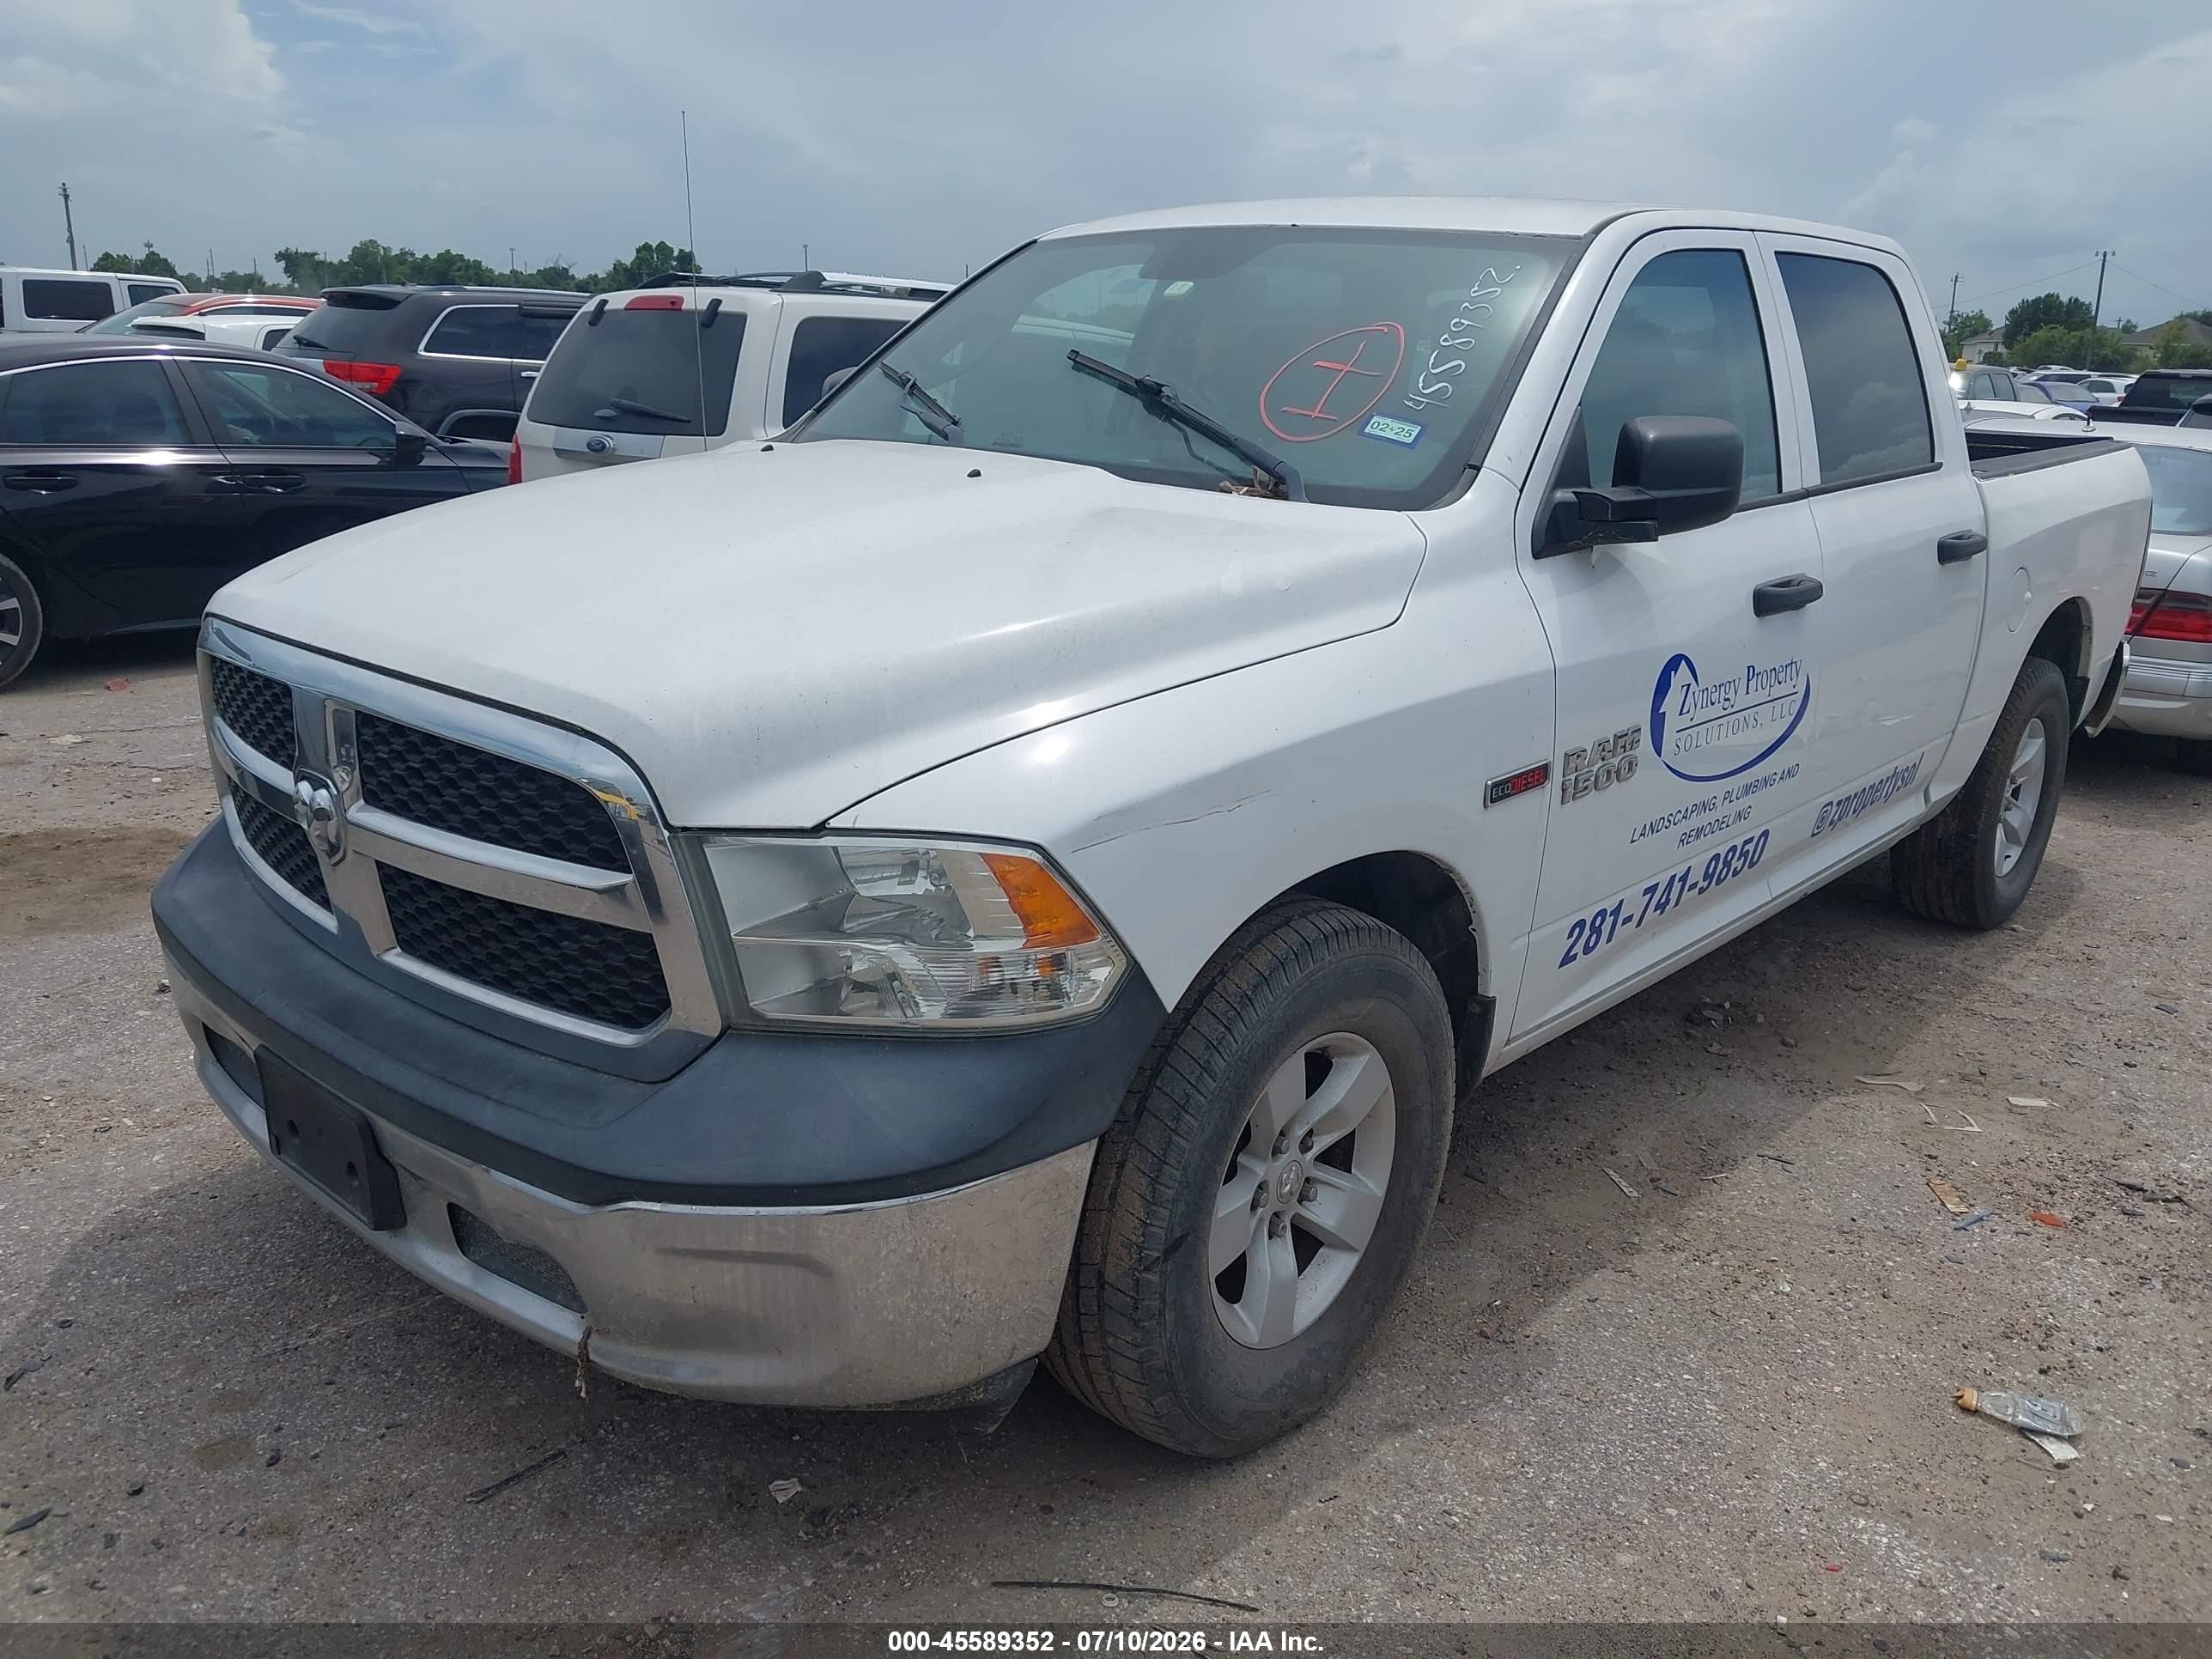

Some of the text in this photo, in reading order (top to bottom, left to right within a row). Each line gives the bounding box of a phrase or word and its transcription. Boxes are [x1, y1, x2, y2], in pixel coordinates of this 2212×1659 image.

[1678, 657, 1803, 722] Zynergy Property
[1562, 724, 1643, 778] RAM
[1674, 699, 1797, 756] SOLUTIONS, LLC
[1560, 754, 1639, 805] 1500
[1630, 763, 1801, 845] LANDSCAPING, PLUMBING AND
[1810, 751, 1925, 838] @zpropertysol
[1676, 805, 1753, 850] REMODELING
[1557, 828, 1771, 969] 281-741-9850
